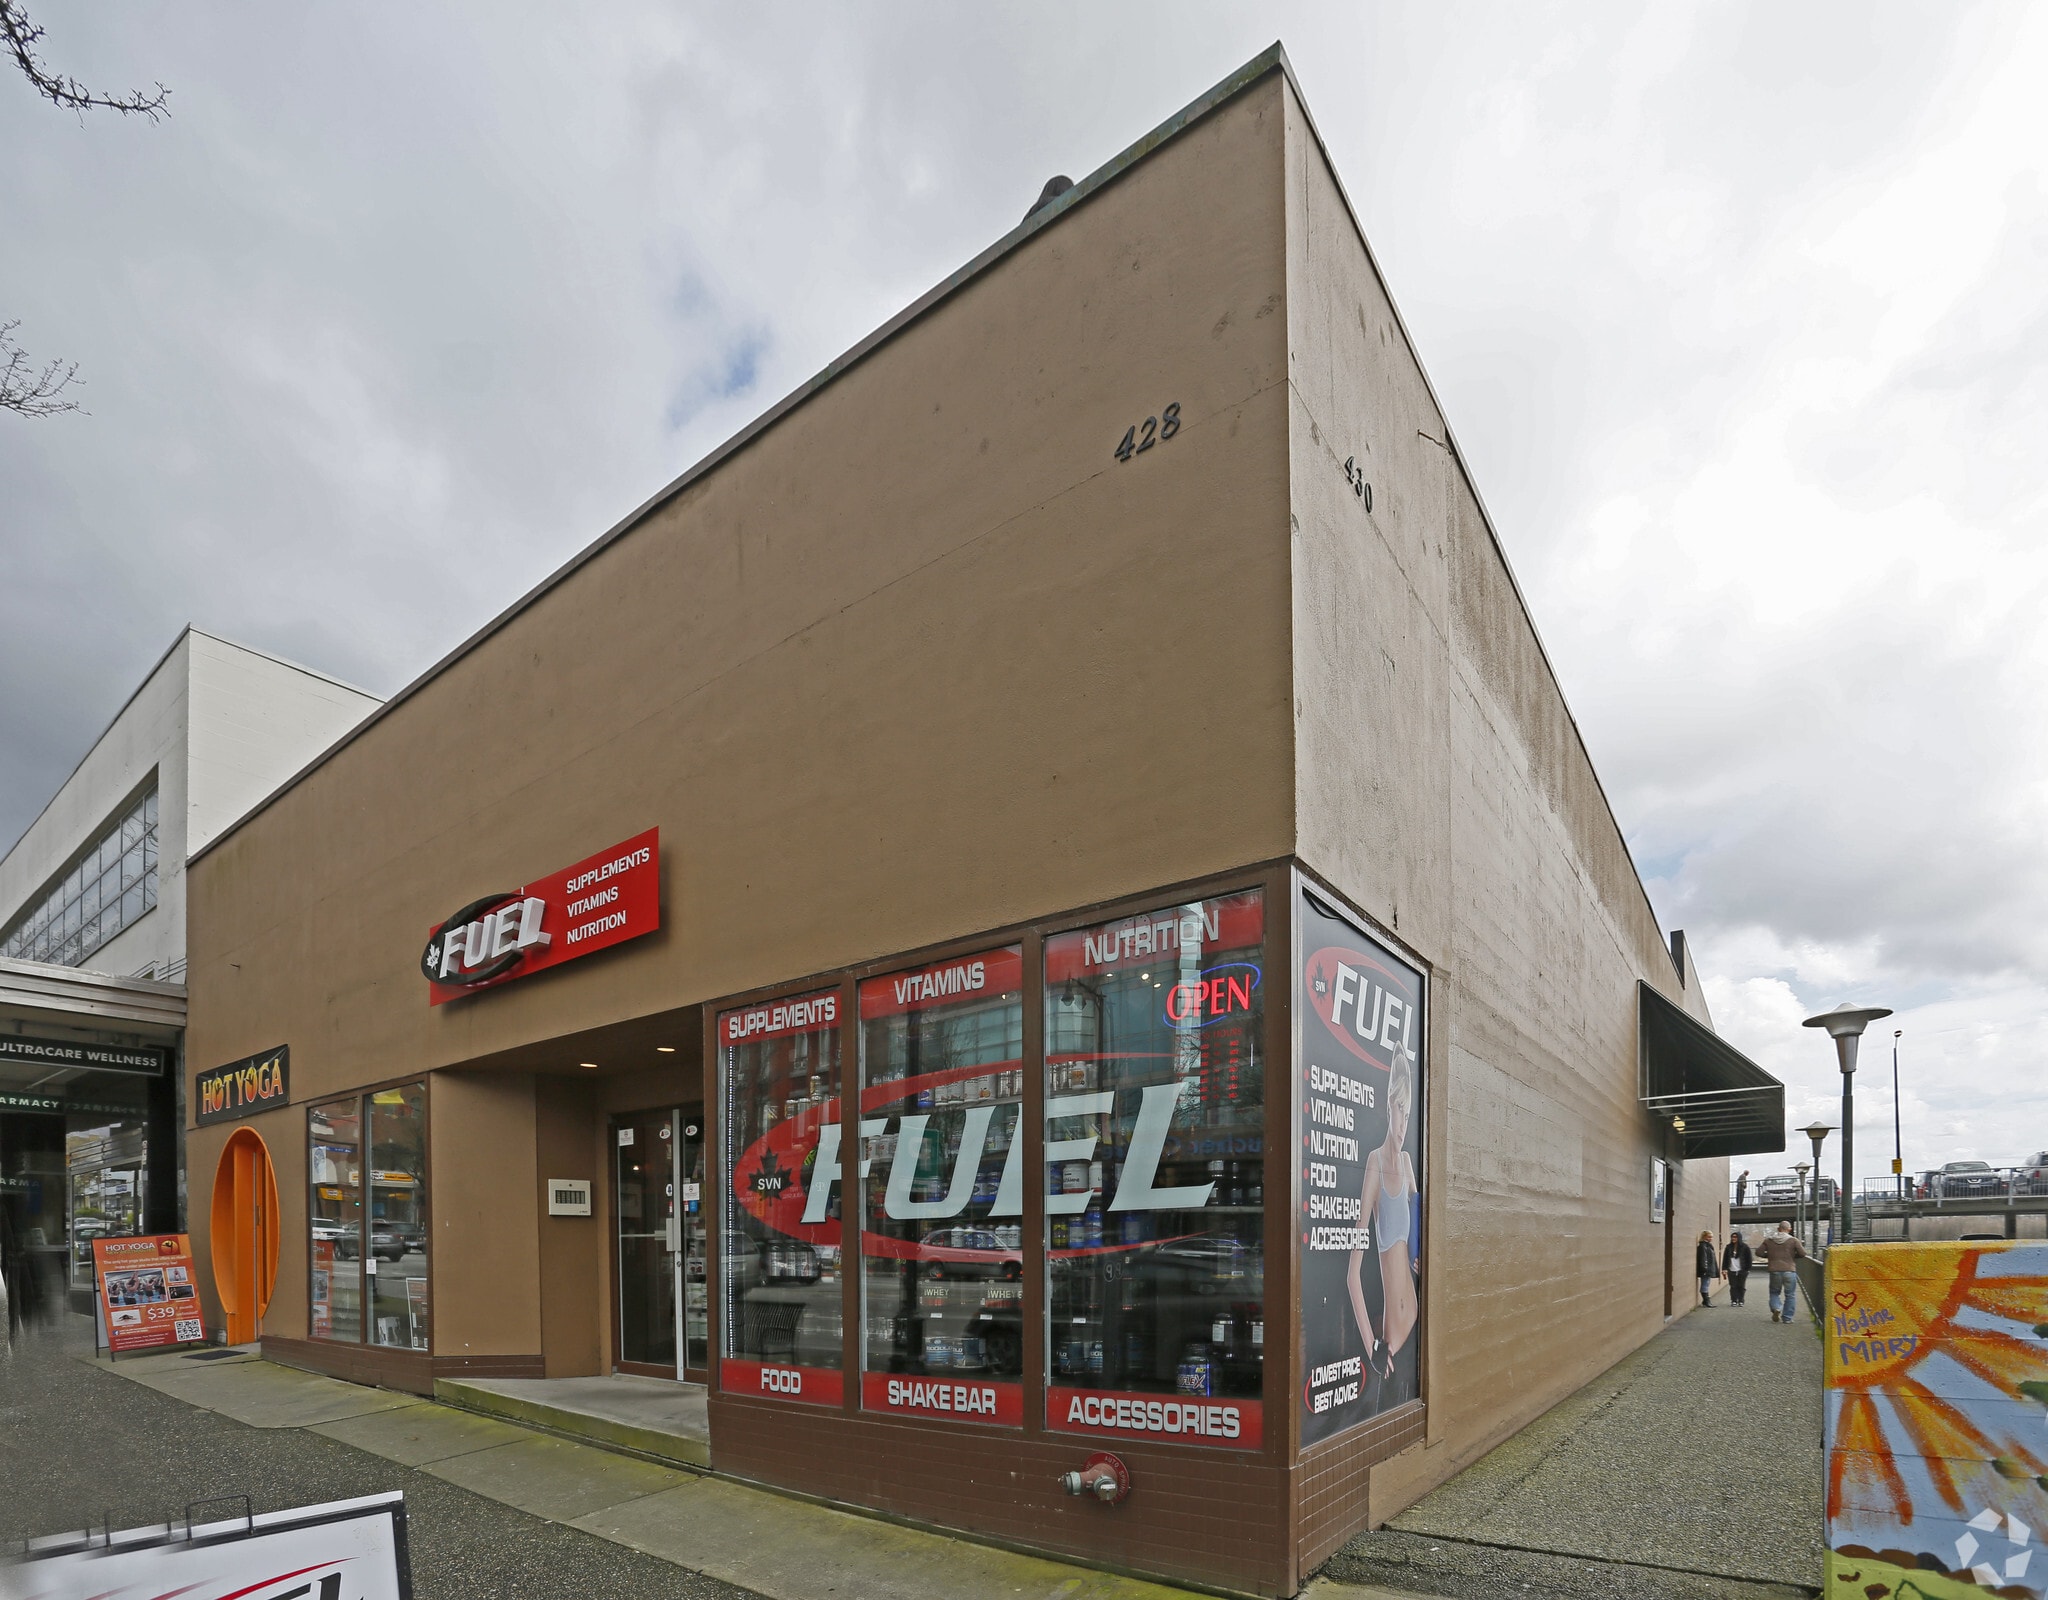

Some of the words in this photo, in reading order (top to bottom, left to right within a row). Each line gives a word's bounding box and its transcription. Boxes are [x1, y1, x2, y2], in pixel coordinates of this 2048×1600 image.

[1114, 402, 1182, 462] 428
[1344, 456, 1373, 514] 430
[566, 848, 649, 894] SUPPLEMENTS
[567, 887, 618, 918] VITAMINS
[440, 897, 552, 978] FUEL
[567, 911, 626, 944] NUTRITION
[1084, 910, 1219, 966] NUTRITION
[895, 962, 985, 1005] VITAMINS
[1167, 974, 1250, 1021] OPEN
[1316, 981, 1325, 993] SVN
[729, 997, 836, 1040] SUPPLEMENTS
[1331, 960, 1416, 1062] FUEL
[87, 1051, 157, 1067] WELLNESS
[203, 1074, 233, 1114] HOT
[235, 1059, 283, 1102] YOGA
[1311, 1064, 1374, 1108] SUPPLEMENTS
[1311, 1097, 1354, 1132] VITAMINS
[801, 1082, 1216, 1223] FUEL
[1311, 1130, 1358, 1161] NUTRITION
[758, 1178, 781, 1190] SVN
[1311, 1162, 1336, 1188] FOOD
[1310, 1194, 1342, 1220] SHAKE
[1343, 1198, 1361, 1220] BAR
[106, 1244, 126, 1252] HOT
[1310, 1227, 1369, 1250] ACCESSORIES
[148, 1307, 175, 1320] $39
[1835, 1308, 1894, 1337] Nadine
[1840, 1334, 1918, 1364] MARY
[761, 1368, 801, 1394] FOOD
[1312, 1361, 1341, 1388] LOWEST
[1342, 1356, 1360, 1378] PRICE
[888, 1380, 950, 1410] SHAKE
[954, 1386, 996, 1415] BAR
[1315, 1390, 1333, 1414] BEST
[1333, 1382, 1358, 1407] ADVICE
[1068, 1396, 1240, 1438] ACCESSORIES
